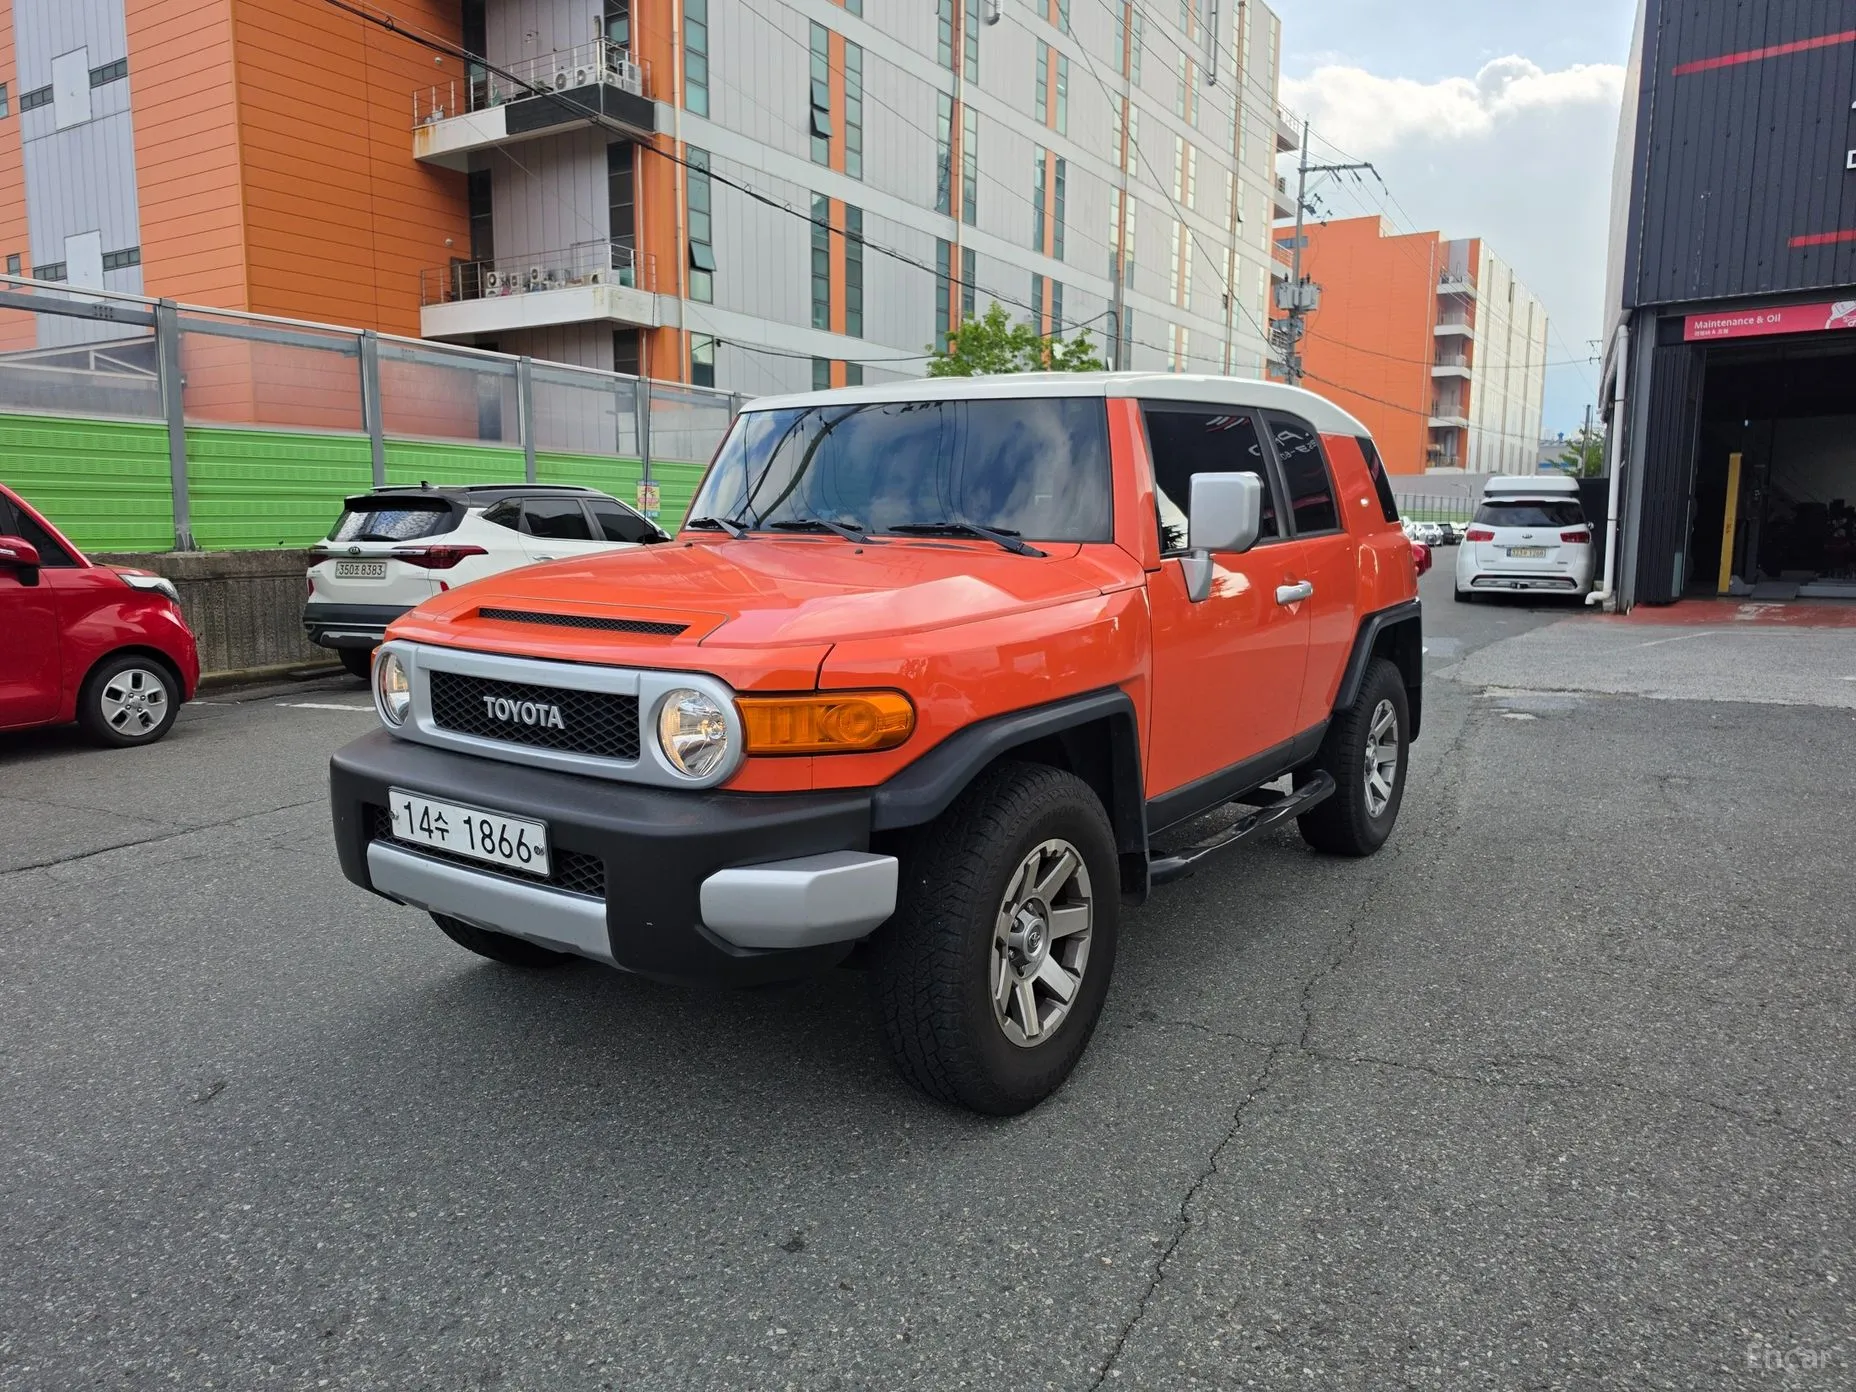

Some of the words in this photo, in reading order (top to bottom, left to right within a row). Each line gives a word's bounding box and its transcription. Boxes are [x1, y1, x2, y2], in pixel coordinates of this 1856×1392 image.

[1694, 317, 1754, 329] Maintenance
[1756, 316, 1764, 324] &
[1767, 313, 1781, 323] Oil
[360, 564, 383, 575] 8383
[483, 696, 565, 730] TOYOTA
[403, 801, 450, 841] 14수
[463, 815, 532, 863] 1866
